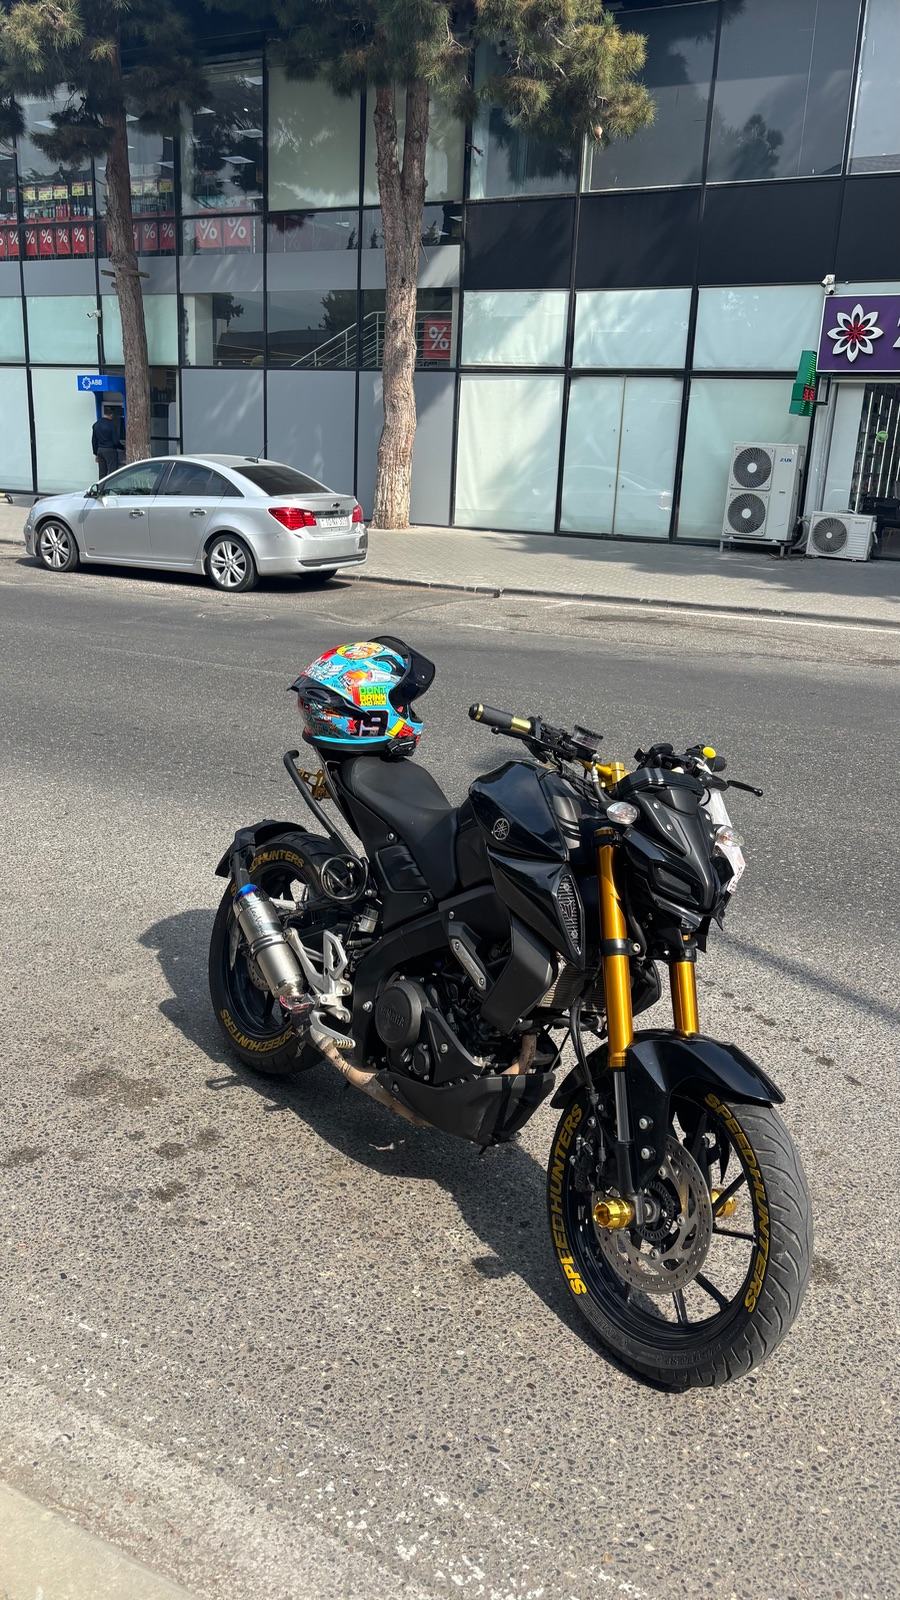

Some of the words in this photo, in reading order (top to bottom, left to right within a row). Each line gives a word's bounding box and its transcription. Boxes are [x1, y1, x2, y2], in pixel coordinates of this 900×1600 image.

[25, 230, 35, 245] %
[41, 229, 52, 244] %
[57, 228, 68, 243] %
[74, 228, 85, 242] %
[144, 223, 156, 240] %
[162, 223, 174, 238] %
[200, 218, 218, 240] %
[228, 217, 247, 239] %
[429, 326, 449, 350] %
[220, 1008, 295, 1052] SPEEDHUNTERS
[549, 1103, 588, 1295] SPEEDHUNTERS
[705, 1092, 770, 1312] SPEEDHUNTERS
